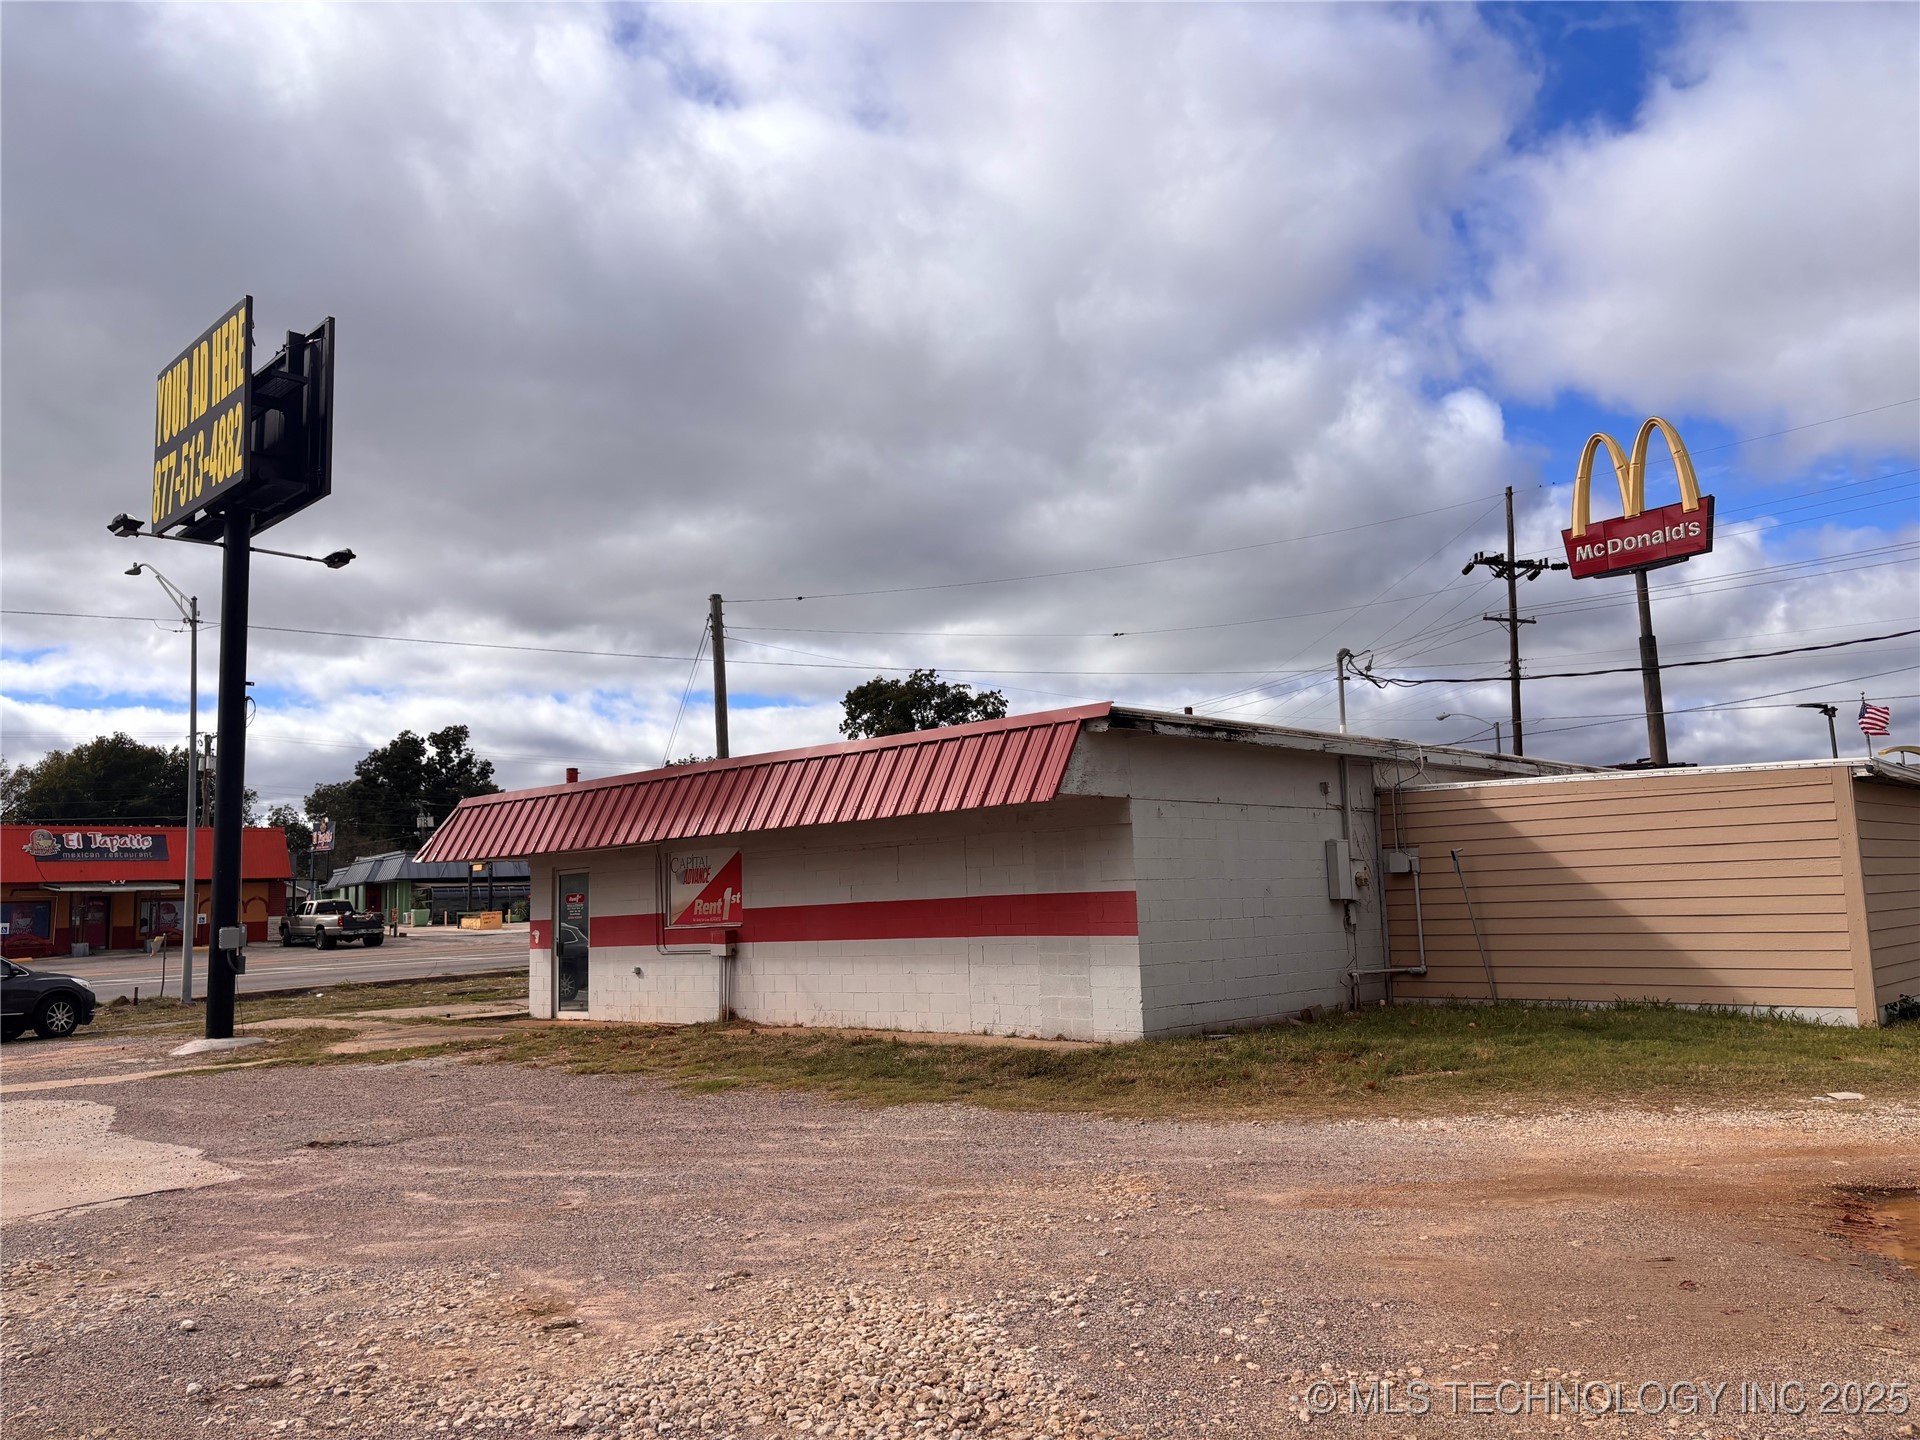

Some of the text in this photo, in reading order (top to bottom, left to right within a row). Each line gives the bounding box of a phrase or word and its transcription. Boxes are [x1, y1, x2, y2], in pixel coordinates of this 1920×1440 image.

[157, 307, 245, 447] YOUR AD HERE
[152, 402, 242, 524] 877-513-4882
[1575, 521, 1701, 562] McDonald's
[62, 832, 152, 852] El Tapatio
[683, 867, 711, 885] ADVANCE
[693, 898, 723, 916] Rent
